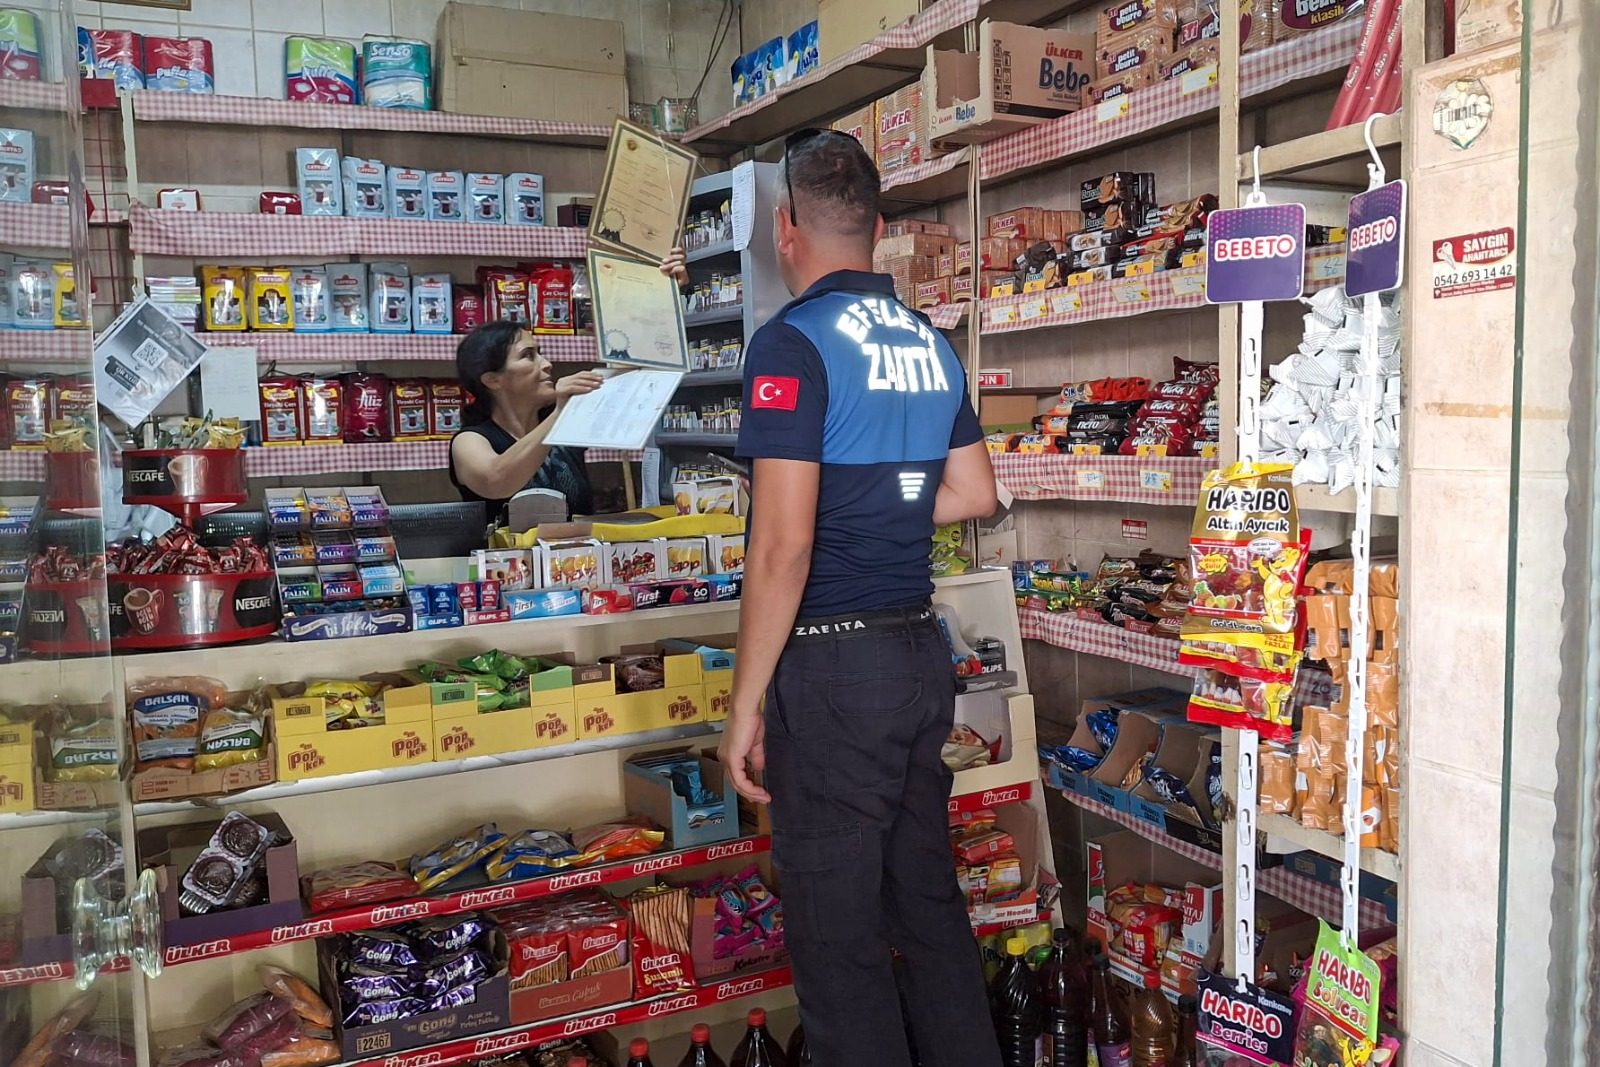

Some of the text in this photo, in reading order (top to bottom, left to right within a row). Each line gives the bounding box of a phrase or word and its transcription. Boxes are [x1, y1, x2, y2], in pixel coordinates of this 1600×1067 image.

[1311, 6, 1345, 25] klasik
[1045, 42, 1084, 61] ÜLKER
[1039, 58, 1091, 91] Bebe
[881, 109, 911, 134] ÜLKER
[955, 104, 976, 123] Bebe
[993, 217, 1014, 229] ÜLKER
[1351, 218, 1395, 250] BEBETO
[1463, 233, 1508, 252] SAYGIN
[1217, 237, 1293, 259] BEBETO
[1434, 264, 1512, 287] 0542 693 14 42
[1207, 489, 1290, 513] HARIBO
[273, 514, 299, 524] FALIM
[315, 514, 339, 524] FALIM
[354, 512, 379, 522] FALIM
[1245, 518, 1289, 533] Ayıcık
[277, 551, 303, 562] FALIM
[319, 548, 344, 559] FALIM
[360, 546, 385, 556] FALIM
[284, 586, 310, 598] FALIM
[326, 584, 351, 595] FALIM
[637, 590, 659, 602] First
[694, 587, 708, 597] 60
[514, 600, 533, 611] First
[144, 694, 190, 706] BALSAN
[668, 699, 692, 720] Pop
[584, 712, 609, 733] Pop
[681, 706, 698, 721] kek
[536, 717, 562, 738] Pop
[550, 724, 568, 739] kek
[598, 718, 614, 733] kek
[206, 736, 251, 750] BALSAN
[392, 736, 420, 757] Pop
[407, 742, 427, 759] kek
[441, 732, 469, 752] Pop
[456, 738, 475, 753] kek
[289, 749, 317, 771] Pop
[304, 756, 325, 772] kek
[982, 789, 1019, 805] ÜLKER
[707, 840, 753, 860] ÜLKER
[633, 855, 682, 874] ÜLKER
[549, 871, 601, 891] ÜLKER
[460, 886, 515, 909] ÜLKER
[371, 901, 429, 924] ÜLKER
[272, 919, 334, 943] ÜLKER
[445, 933, 468, 949] Gong
[583, 934, 617, 949] ÜLKER
[166, 939, 231, 963] ÜLKER
[366, 949, 392, 962] Gong
[446, 963, 469, 981] Gong
[641, 953, 680, 972] ÜLKER
[643, 968, 683, 986] Susamlı
[1318, 949, 1372, 1006] HARIBO
[363, 986, 391, 998] Gong
[717, 979, 764, 1000] ÜLKER
[648, 995, 697, 1016] ÜLKER
[1202, 988, 1283, 1039] HARIBO
[1313, 979, 1369, 1031] Solucan
[371, 1011, 399, 1024] Gong
[419, 1014, 457, 1034] Gong
[564, 1013, 616, 1034] ÜLKER
[362, 1034, 390, 1051] 22467
[475, 1033, 530, 1055] ÜLKER
[1211, 1021, 1269, 1055] Berries
